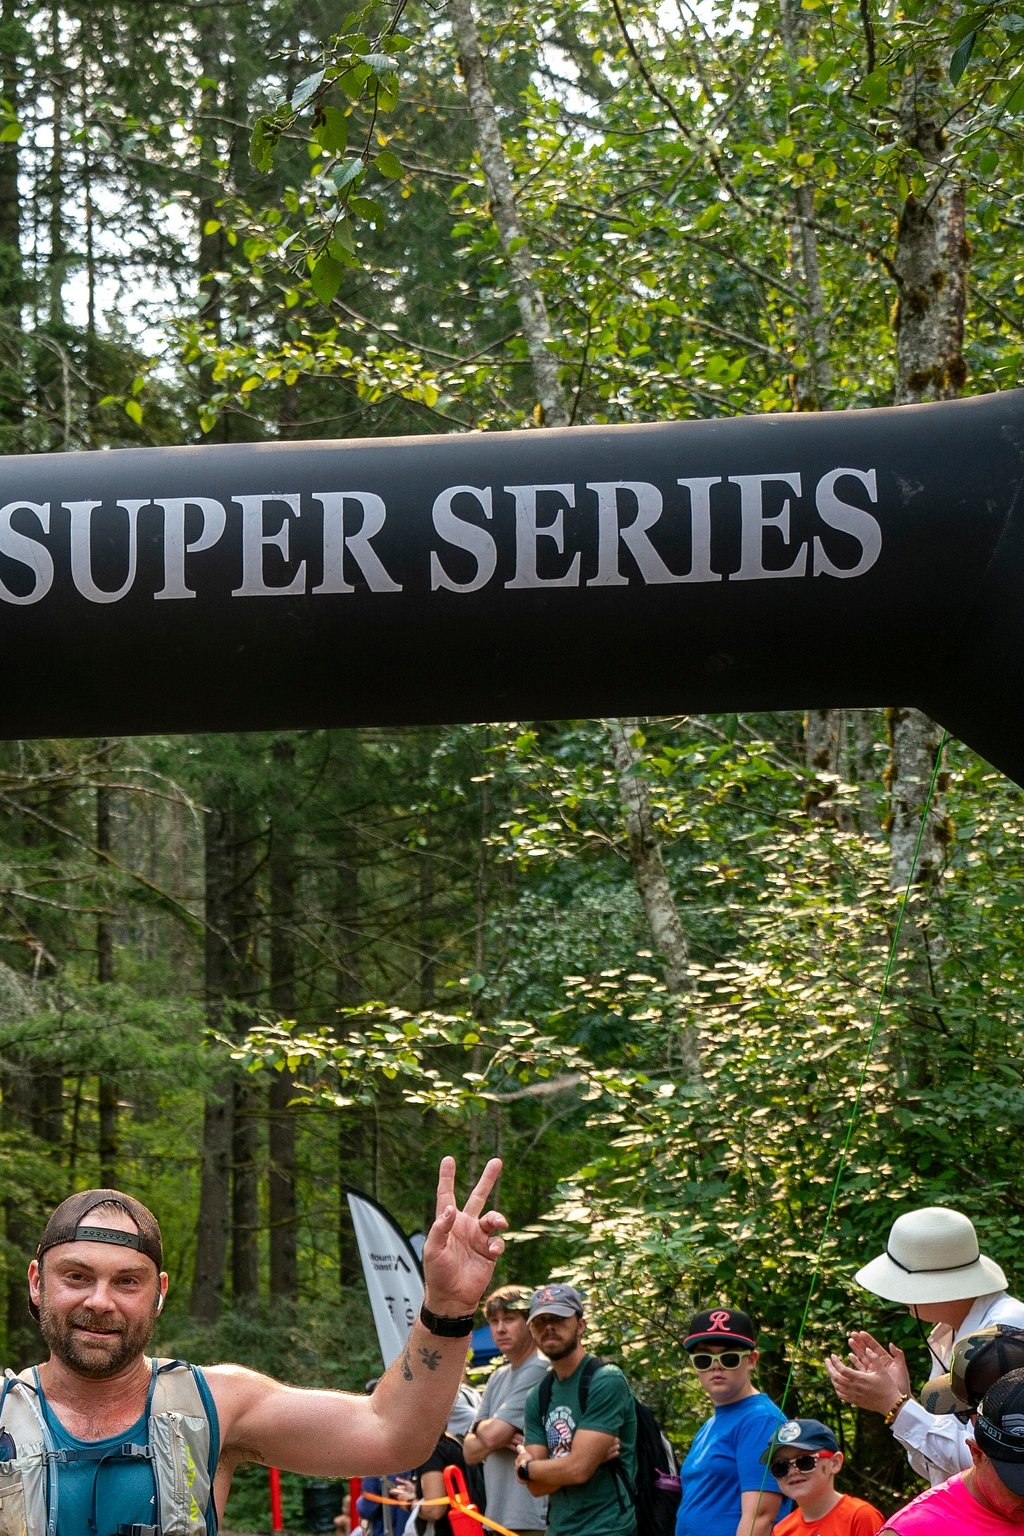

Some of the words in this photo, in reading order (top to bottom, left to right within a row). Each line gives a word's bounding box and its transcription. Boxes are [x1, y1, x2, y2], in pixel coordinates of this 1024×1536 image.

[431, 467, 882, 593] SERIES
[374, 1263, 393, 1271] oast
[707, 1311, 731, 1331] R
